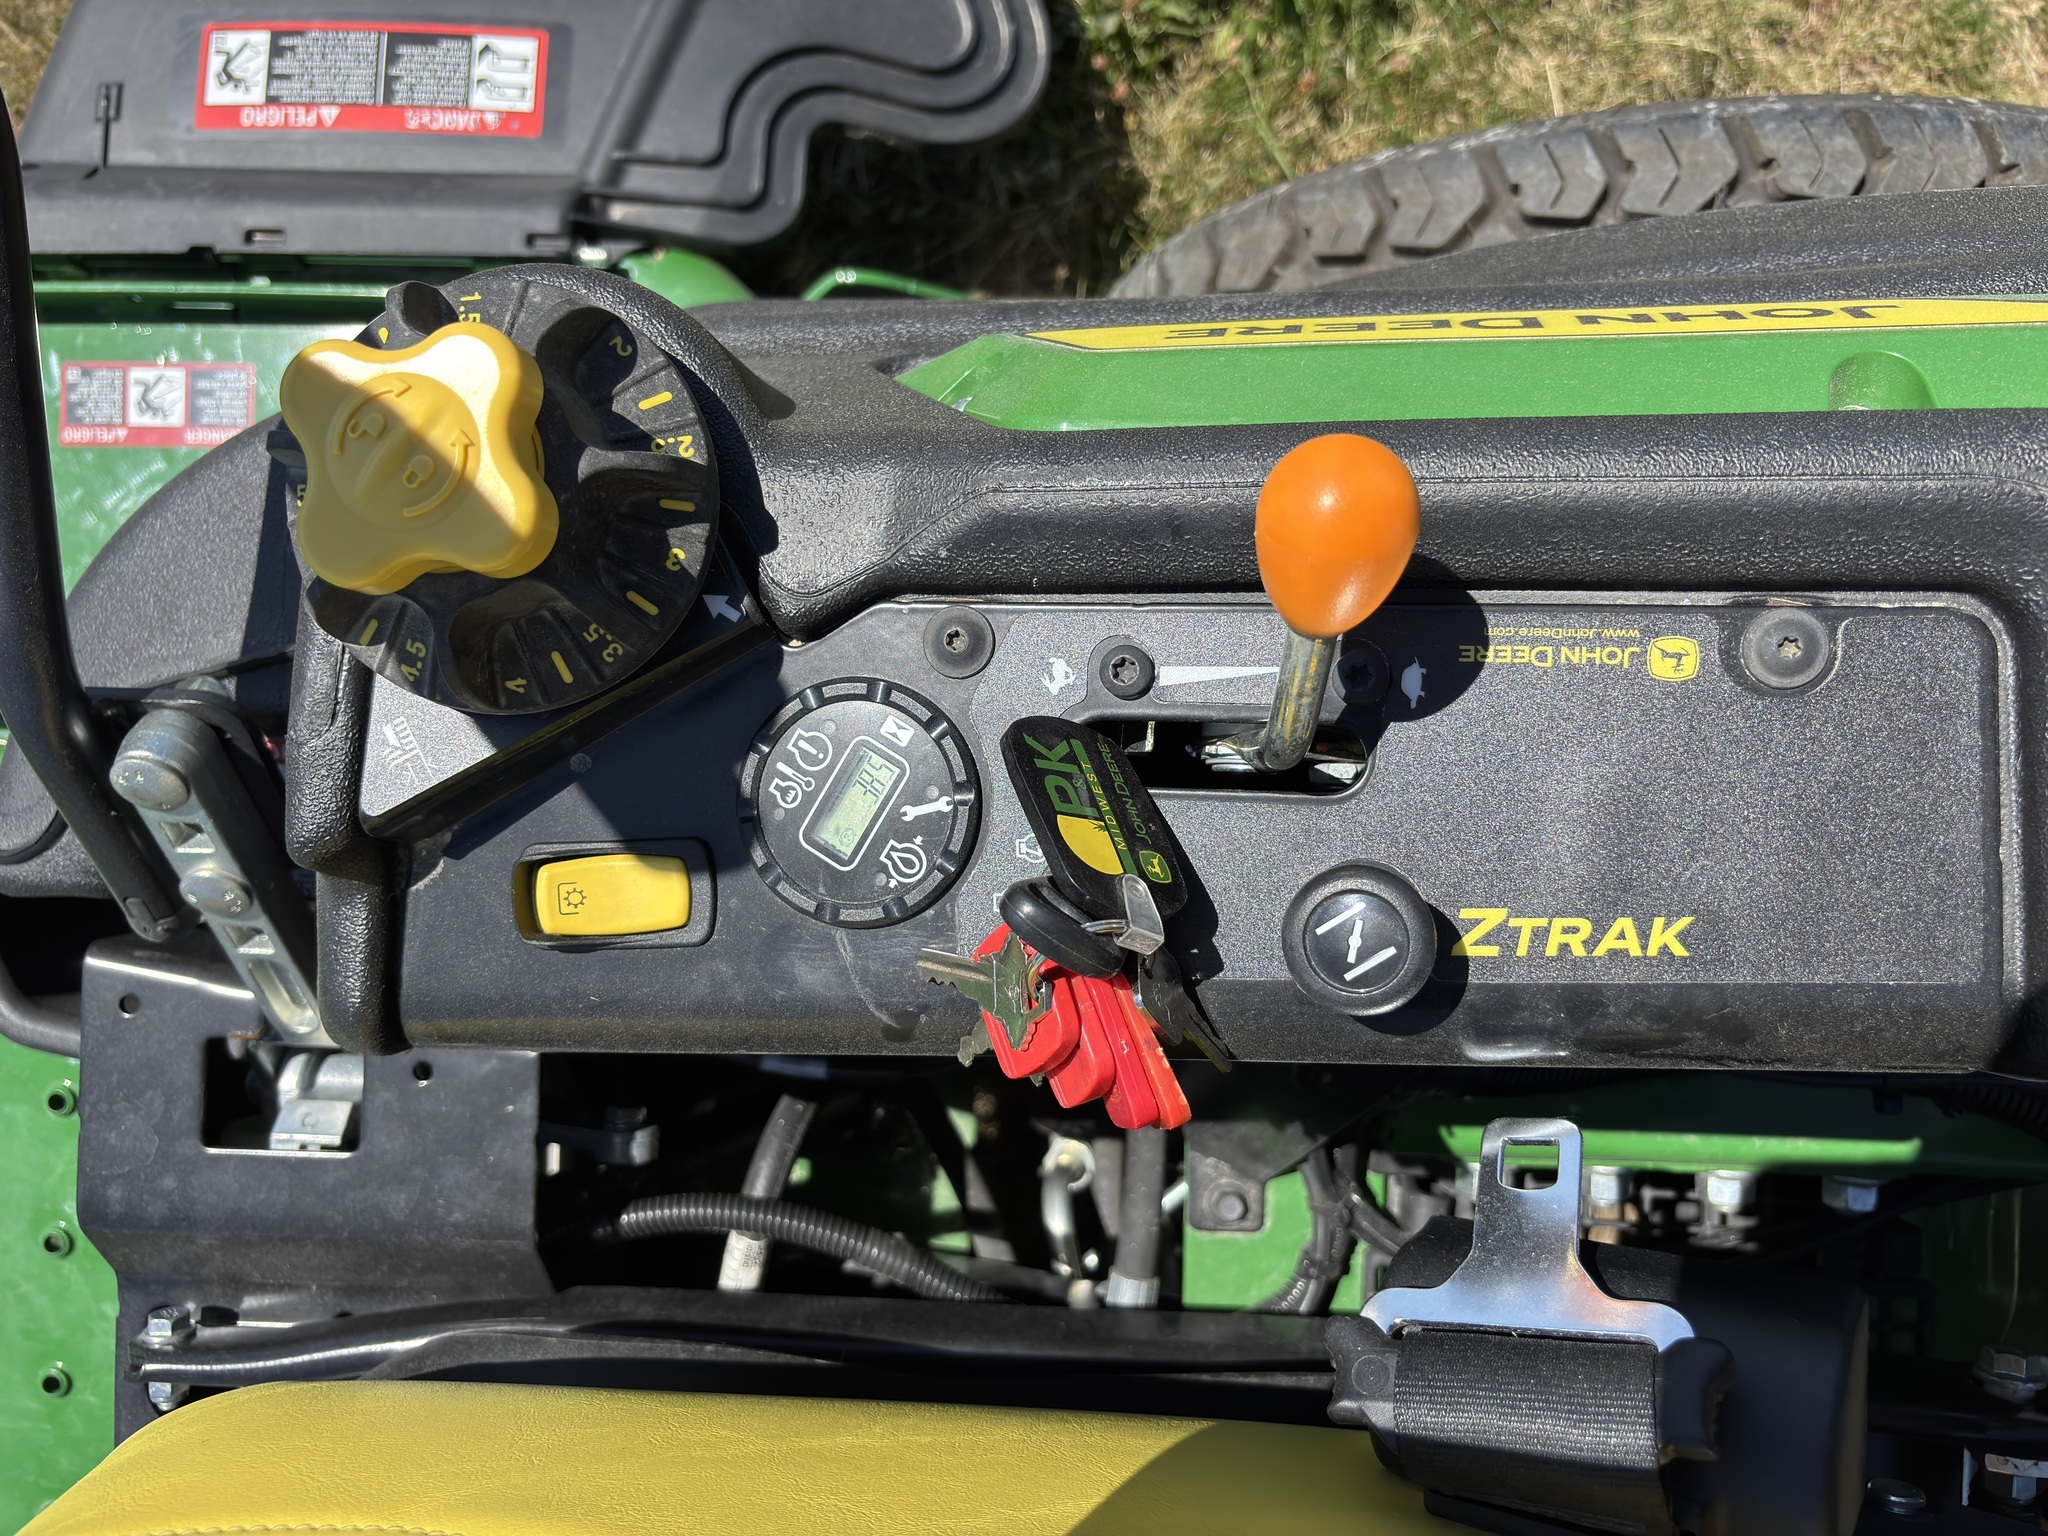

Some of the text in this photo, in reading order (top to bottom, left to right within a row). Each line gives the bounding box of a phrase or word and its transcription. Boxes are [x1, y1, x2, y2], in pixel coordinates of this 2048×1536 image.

[240, 106, 319, 127] PELIGRO
[1163, 304, 1900, 340] JOHN DEERE
[609, 334, 633, 357] 2
[665, 547, 686, 572] 3
[583, 622, 623, 664] 3.5
[1484, 627, 1640, 640] www.JohnDeere.com
[401, 641, 426, 683] 4.5
[1458, 645, 1640, 668] JOHN DEERE
[505, 677, 528, 693] 4
[1081, 761, 1127, 851] MIDWEST
[1098, 742, 1152, 845] JOHN DEERE
[1451, 907, 1695, 957] ZTRAK
